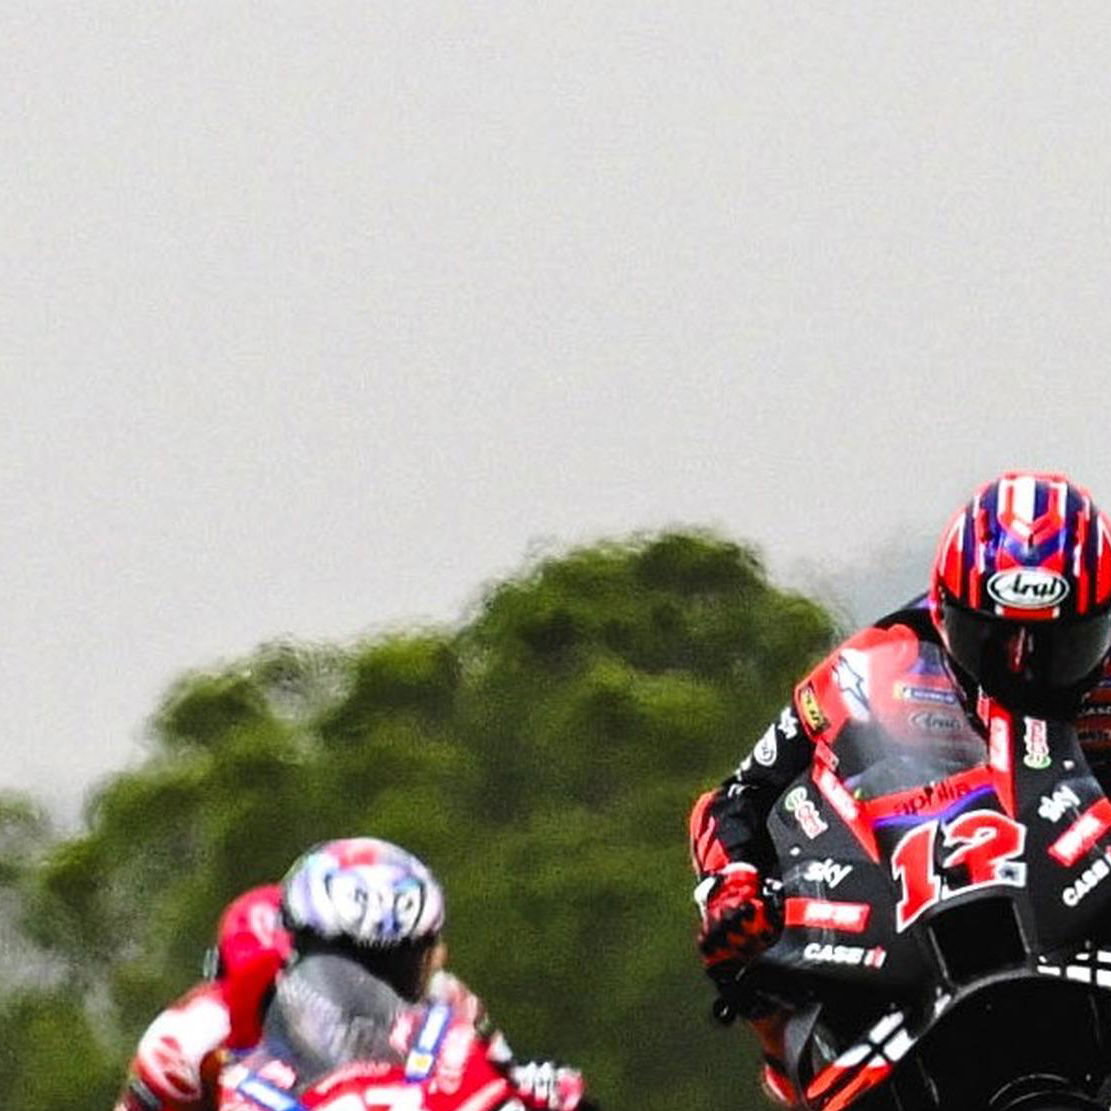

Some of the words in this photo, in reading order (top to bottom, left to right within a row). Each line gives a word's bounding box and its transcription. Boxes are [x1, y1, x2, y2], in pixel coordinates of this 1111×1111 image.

[1003, 572, 1058, 600] Arai
[804, 858, 853, 888] sky
[891, 808, 1027, 933] 12
[803, 942, 864, 964] CASE
